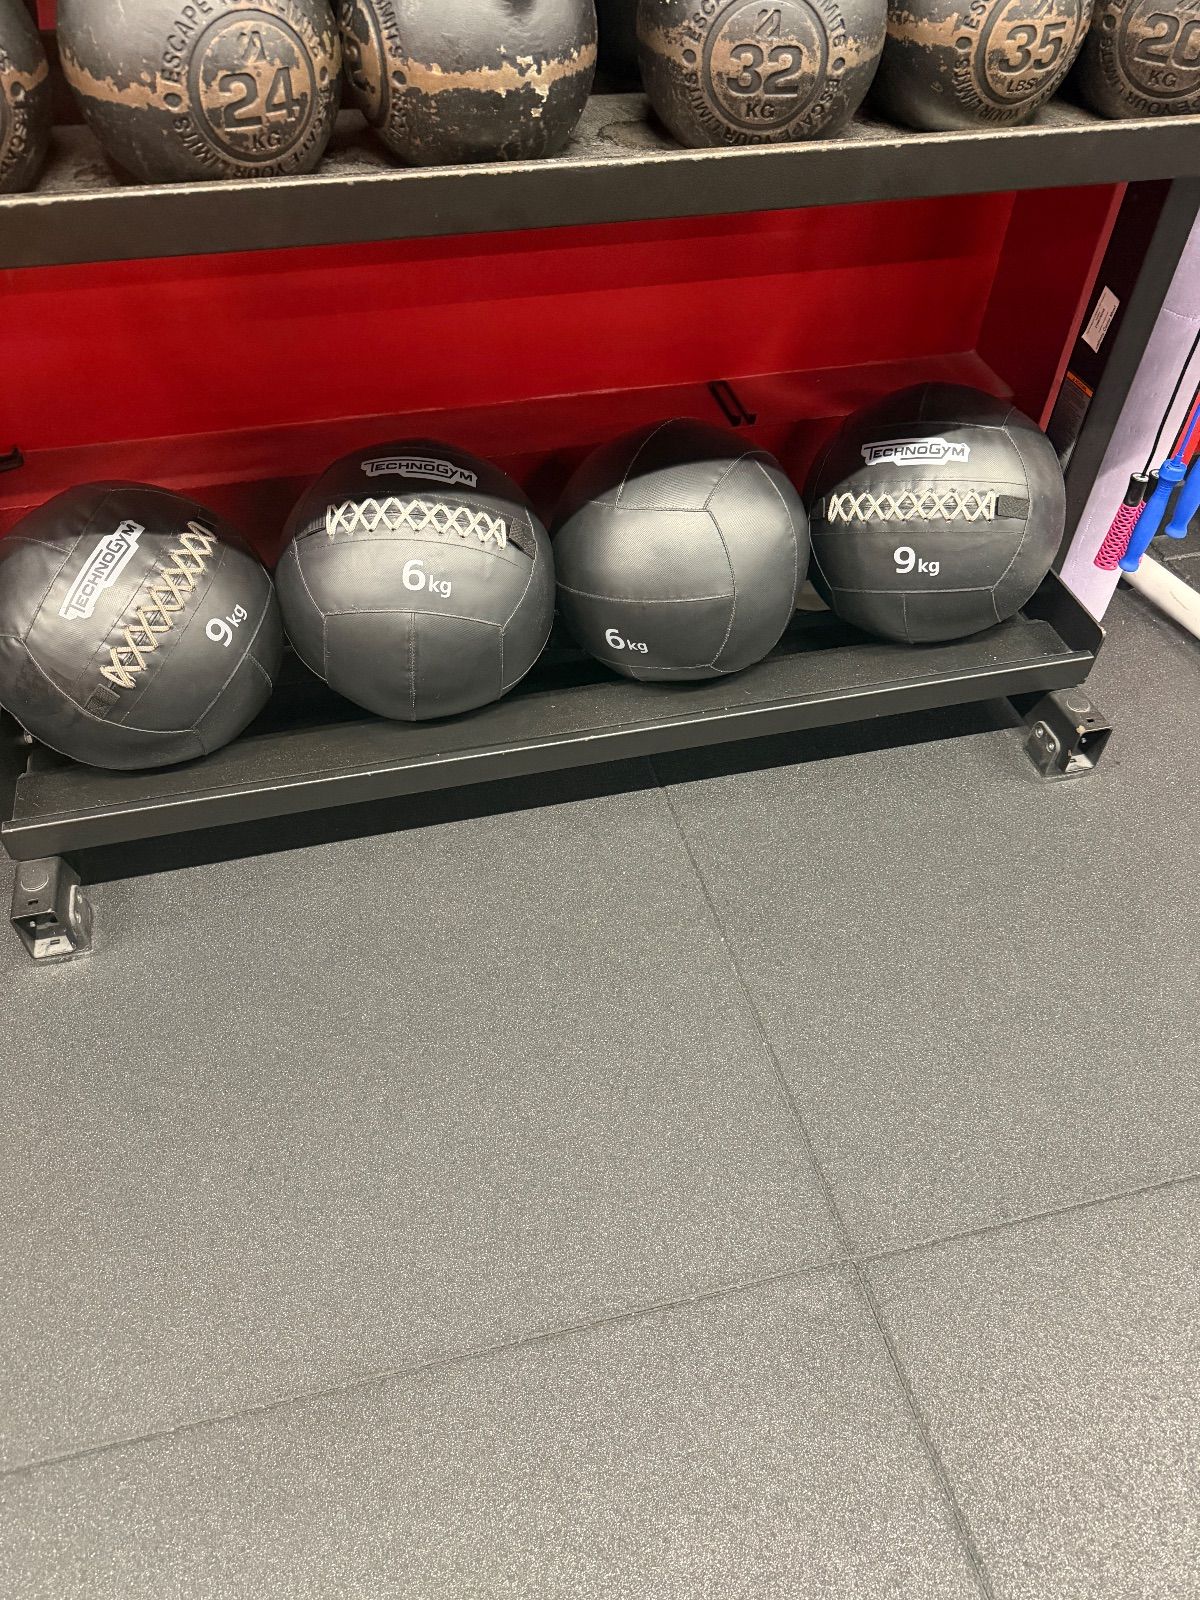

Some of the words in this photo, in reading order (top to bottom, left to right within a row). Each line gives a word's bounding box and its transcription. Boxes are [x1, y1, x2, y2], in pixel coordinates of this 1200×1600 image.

[162, 0, 213, 83] ESCAPE
[817, 0, 846, 47] MITS
[998, 21, 1067, 70] 35
[727, 43, 802, 95] 32
[1006, 77, 1038, 93] LBS
[1148, 69, 1177, 87] KG
[218, 66, 303, 128] 24
[685, 71, 722, 135] LIMITS
[745, 103, 776, 119] KG
[252, 132, 282, 150] KG
